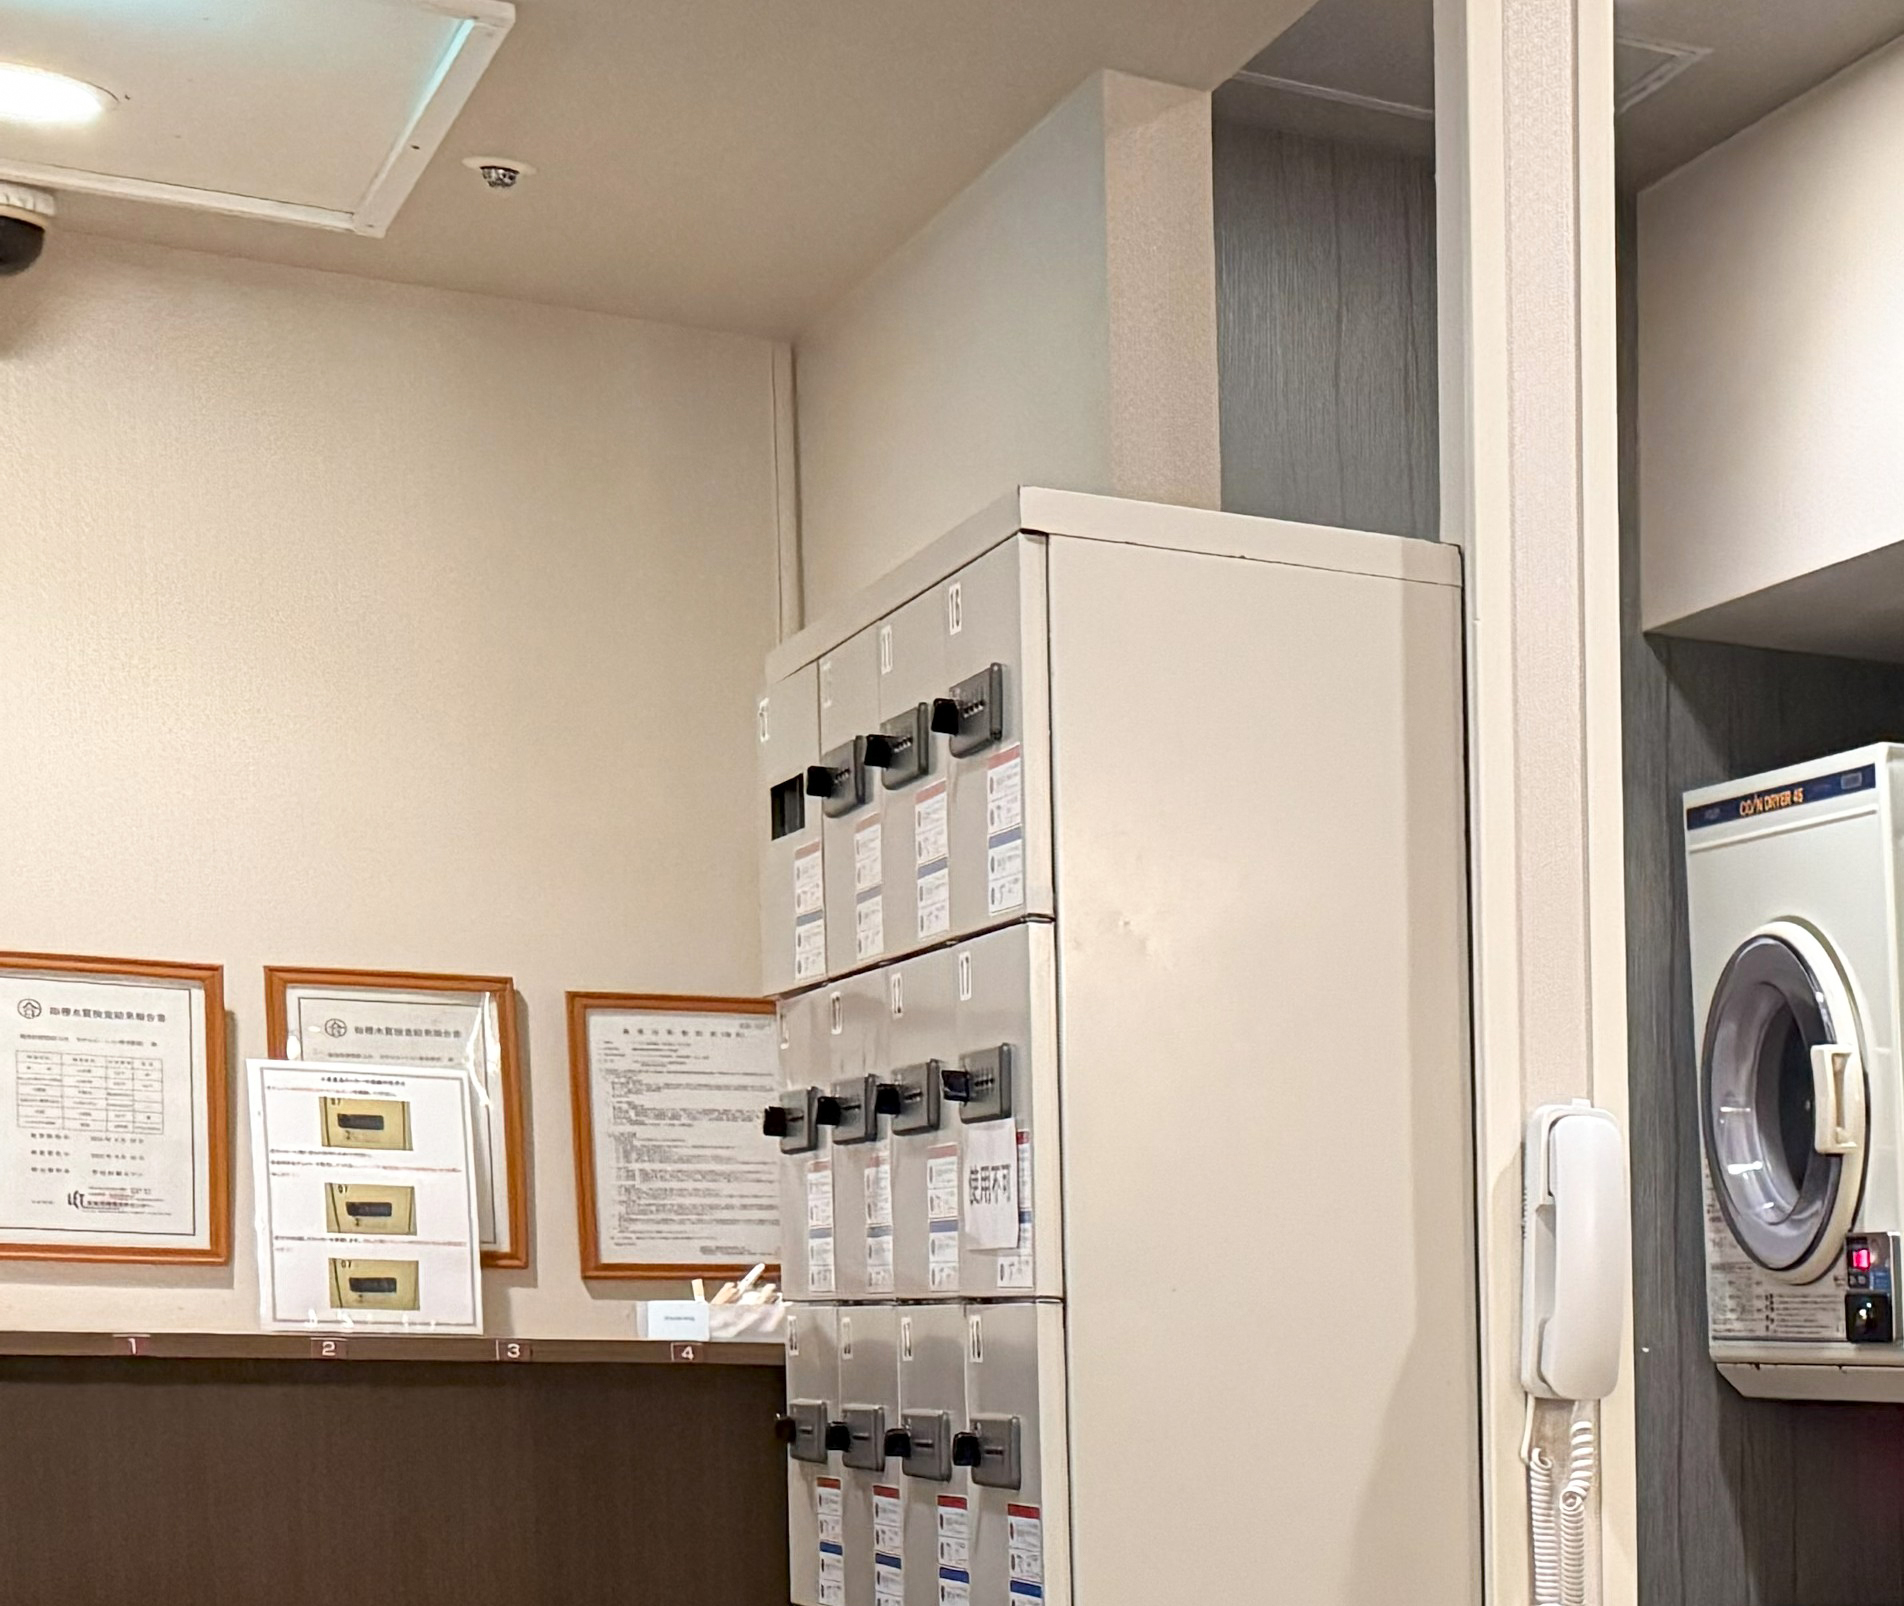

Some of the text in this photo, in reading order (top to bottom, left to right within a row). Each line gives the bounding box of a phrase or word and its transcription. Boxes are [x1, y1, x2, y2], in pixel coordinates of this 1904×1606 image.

[1764, 791, 1791, 811] DRYER
[1793, 788, 1804, 804] 45
[969, 1166, 1011, 1206] 使用不可
[128, 1338, 137, 1353] 1
[321, 1342, 336, 1356] 2
[507, 1344, 520, 1358] 3
[681, 1345, 694, 1359] 4
